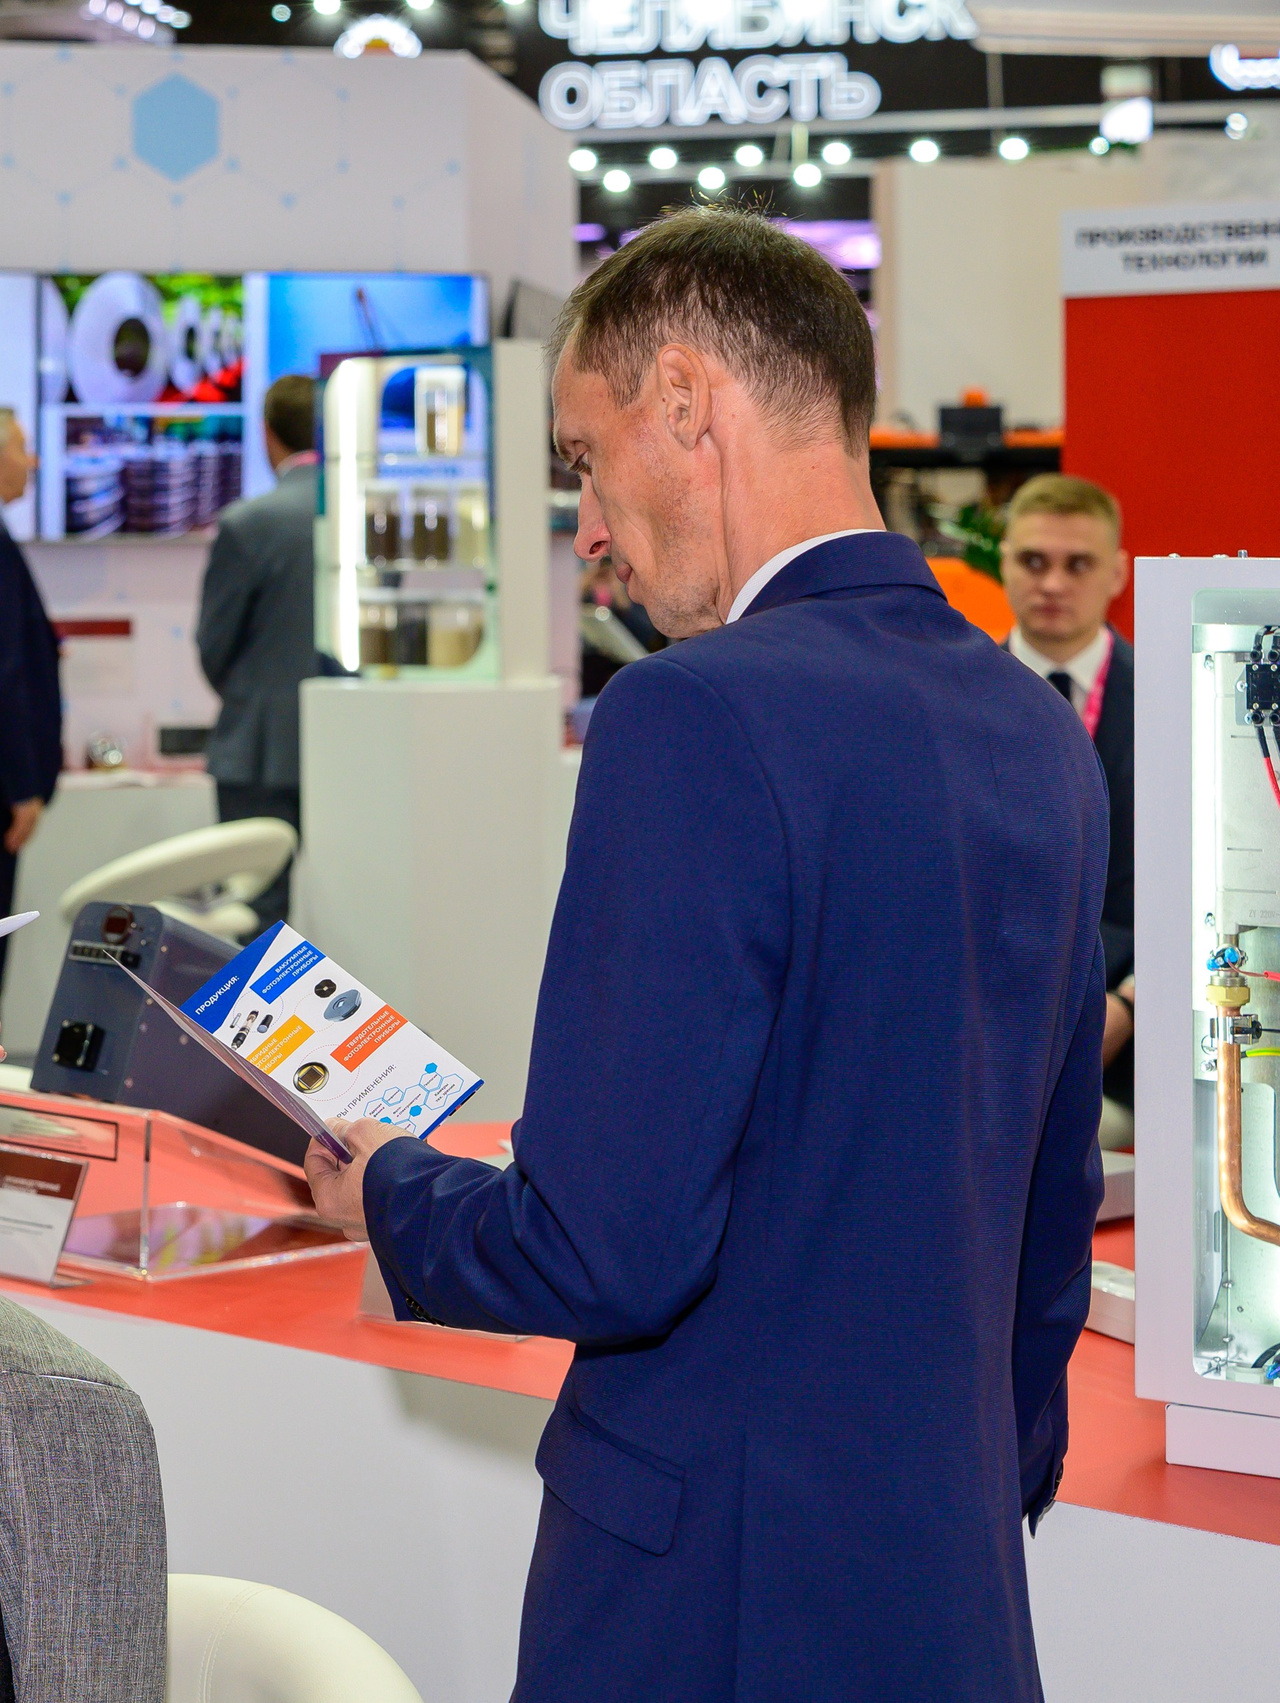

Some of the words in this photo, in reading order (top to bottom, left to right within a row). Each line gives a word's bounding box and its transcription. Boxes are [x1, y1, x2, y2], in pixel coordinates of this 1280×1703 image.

[538, 52, 882, 130] ОБЛАСТЬ
[261, 950, 314, 994] ФОТОЭЛЕКТРОННЫЕ
[275, 945, 308, 973] ВАКУУМНЫЕ
[292, 954, 319, 977] ПРИБОРЫ
[195, 975, 240, 1015] ПРОДУКЦИЯ:
[343, 1014, 395, 1062] ФОТОЭЛЕКТРОННЫЕ
[346, 1010, 390, 1049] ТВЕРДОТЕЛЬНЫЕ
[374, 1019, 401, 1044] ПРИБОРЫ
[348, 1063, 397, 1110] ПРИМЕНЕНИЯ:
